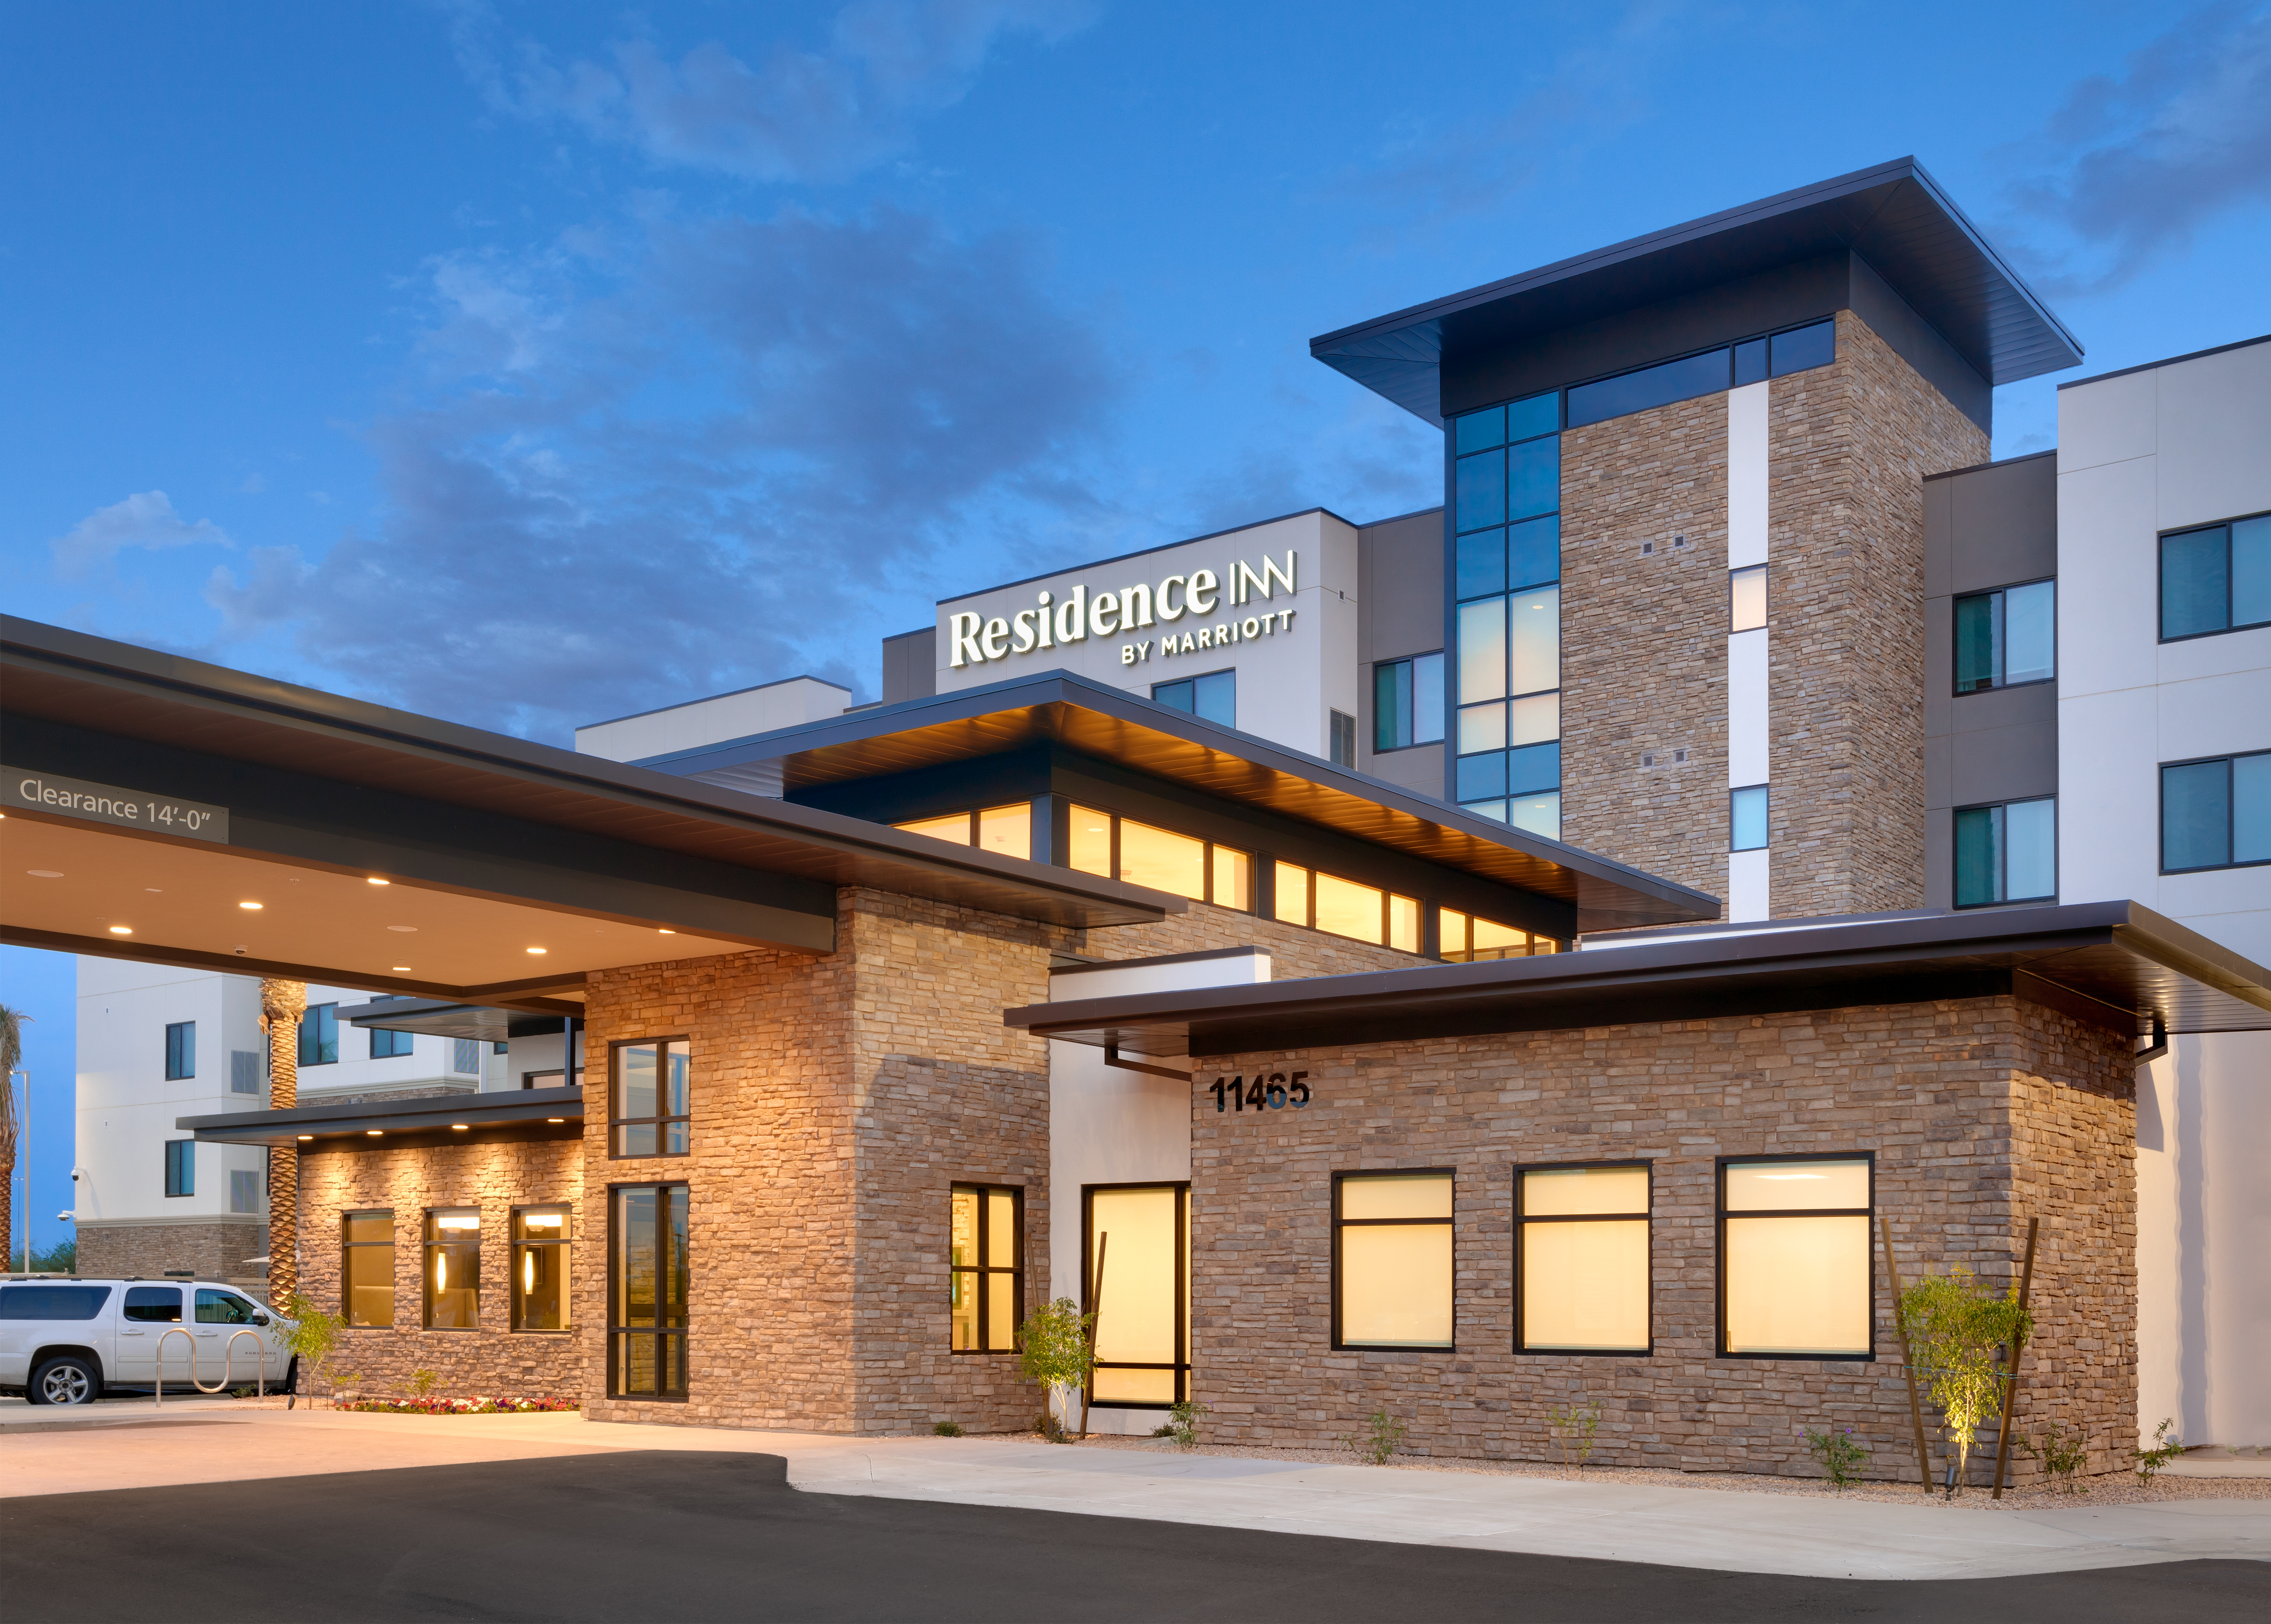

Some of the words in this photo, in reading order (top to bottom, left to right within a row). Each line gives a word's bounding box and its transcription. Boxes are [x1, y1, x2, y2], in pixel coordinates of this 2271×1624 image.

[949, 569, 1217, 667] Residence
[1229, 550, 1295, 606] INN
[1122, 640, 1151, 665] BY
[1161, 609, 1294, 657] MARRIOTT
[20, 779, 138, 819] Clearance
[1209, 1071, 1309, 1112] 11465
